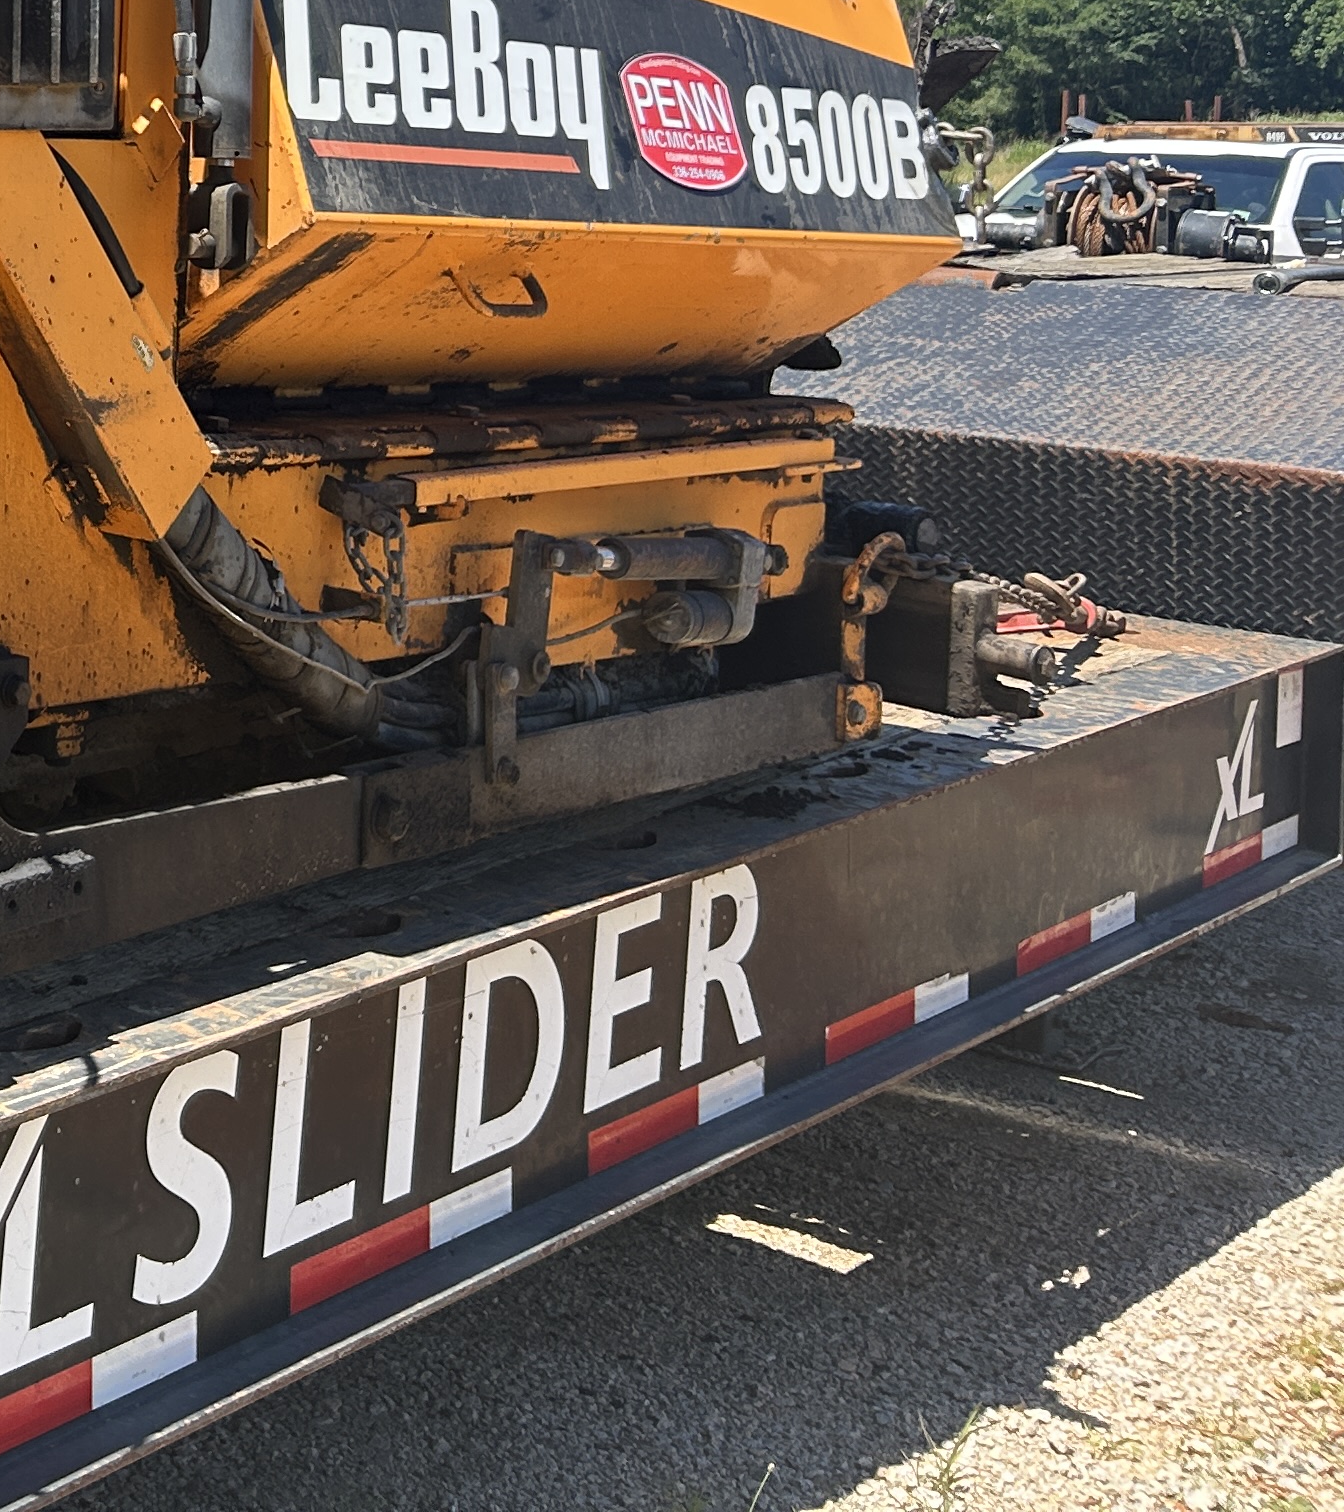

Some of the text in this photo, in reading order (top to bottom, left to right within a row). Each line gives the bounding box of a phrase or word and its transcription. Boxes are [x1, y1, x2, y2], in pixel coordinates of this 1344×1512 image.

[627, 74, 732, 134] PENN
[641, 128, 738, 155] MCMICHAEL
[745, 84, 930, 200] 8500B
[1308, 131, 1344, 141] VOL
[1204, 698, 1265, 856] XL
[132, 862, 763, 1307] SLIDER
